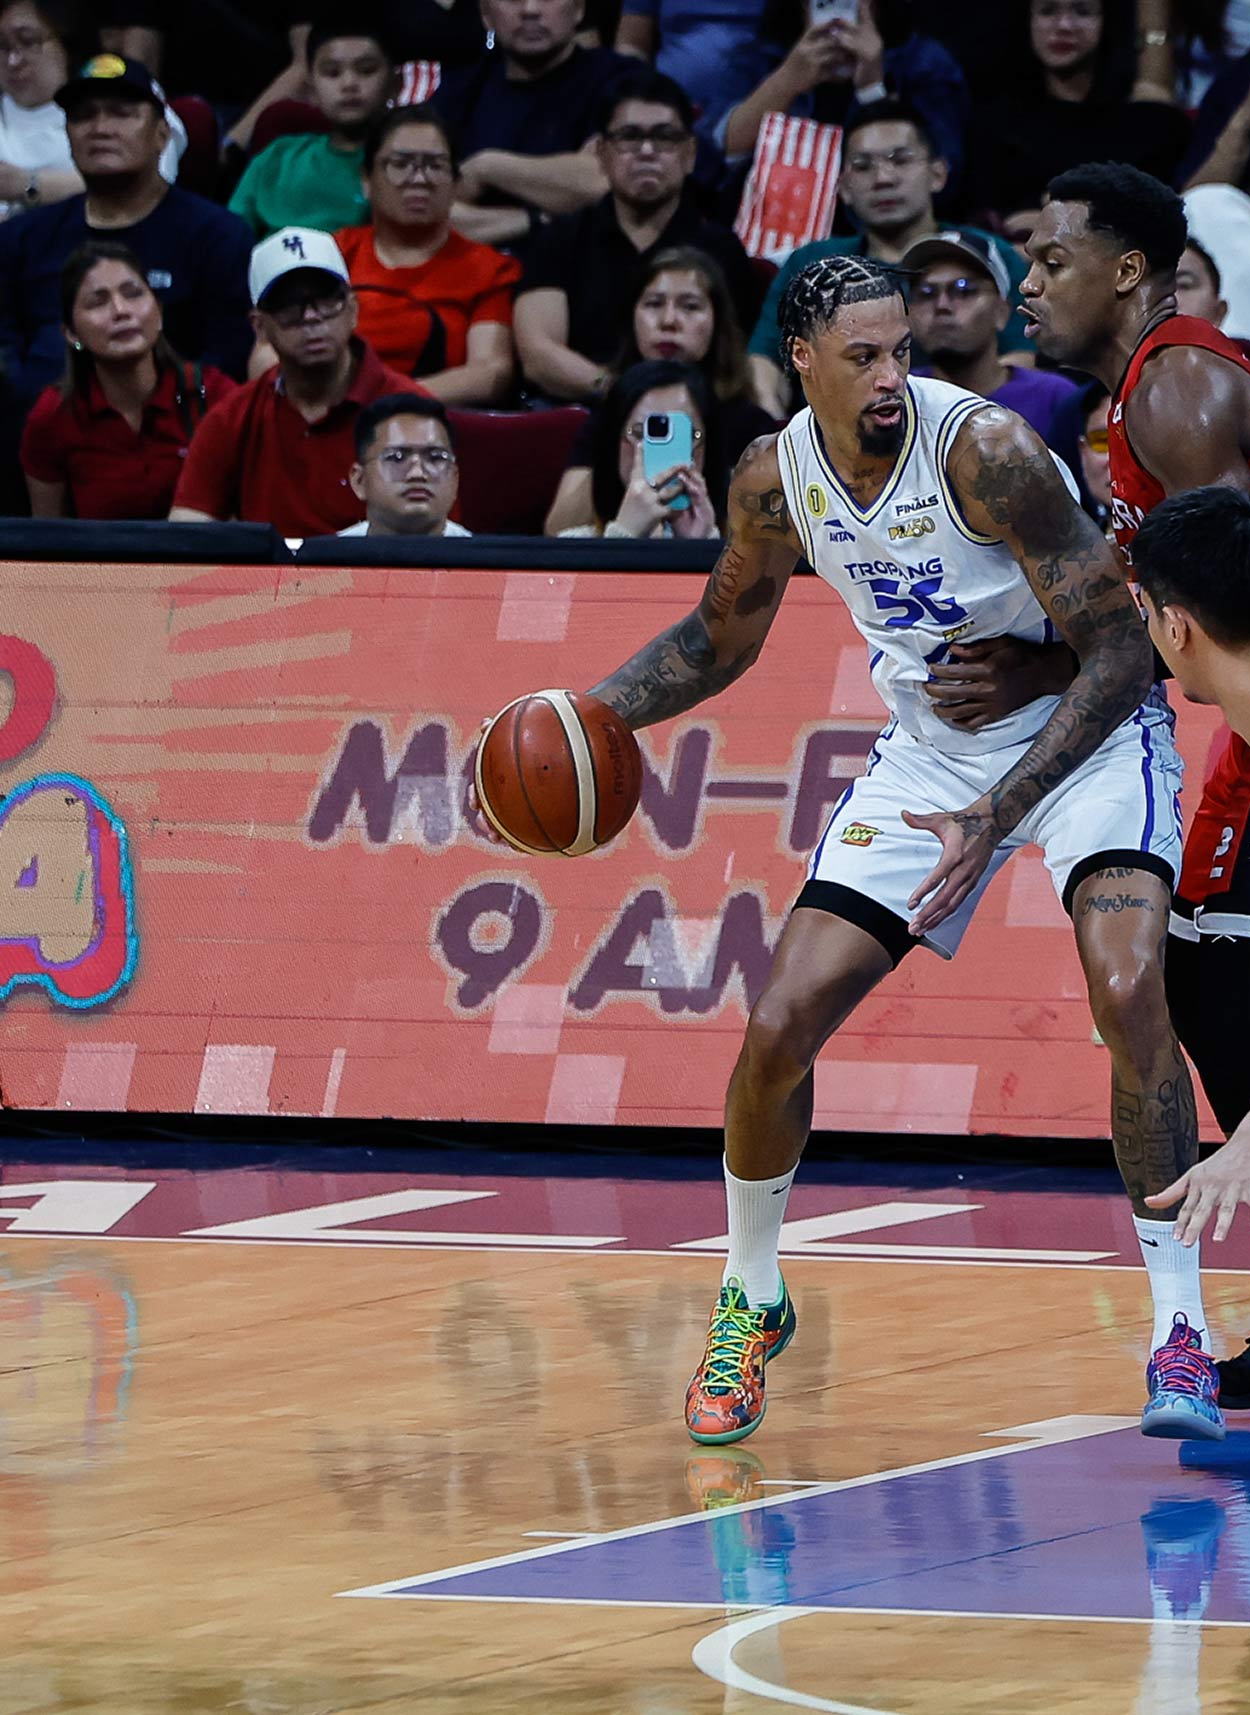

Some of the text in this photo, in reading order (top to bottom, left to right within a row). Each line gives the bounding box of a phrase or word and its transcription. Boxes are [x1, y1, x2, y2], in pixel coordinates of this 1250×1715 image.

[896, 494, 939, 517] FINALS
[844, 557, 944, 580] TROPANG
[438, 881, 804, 1011] 9 AM
